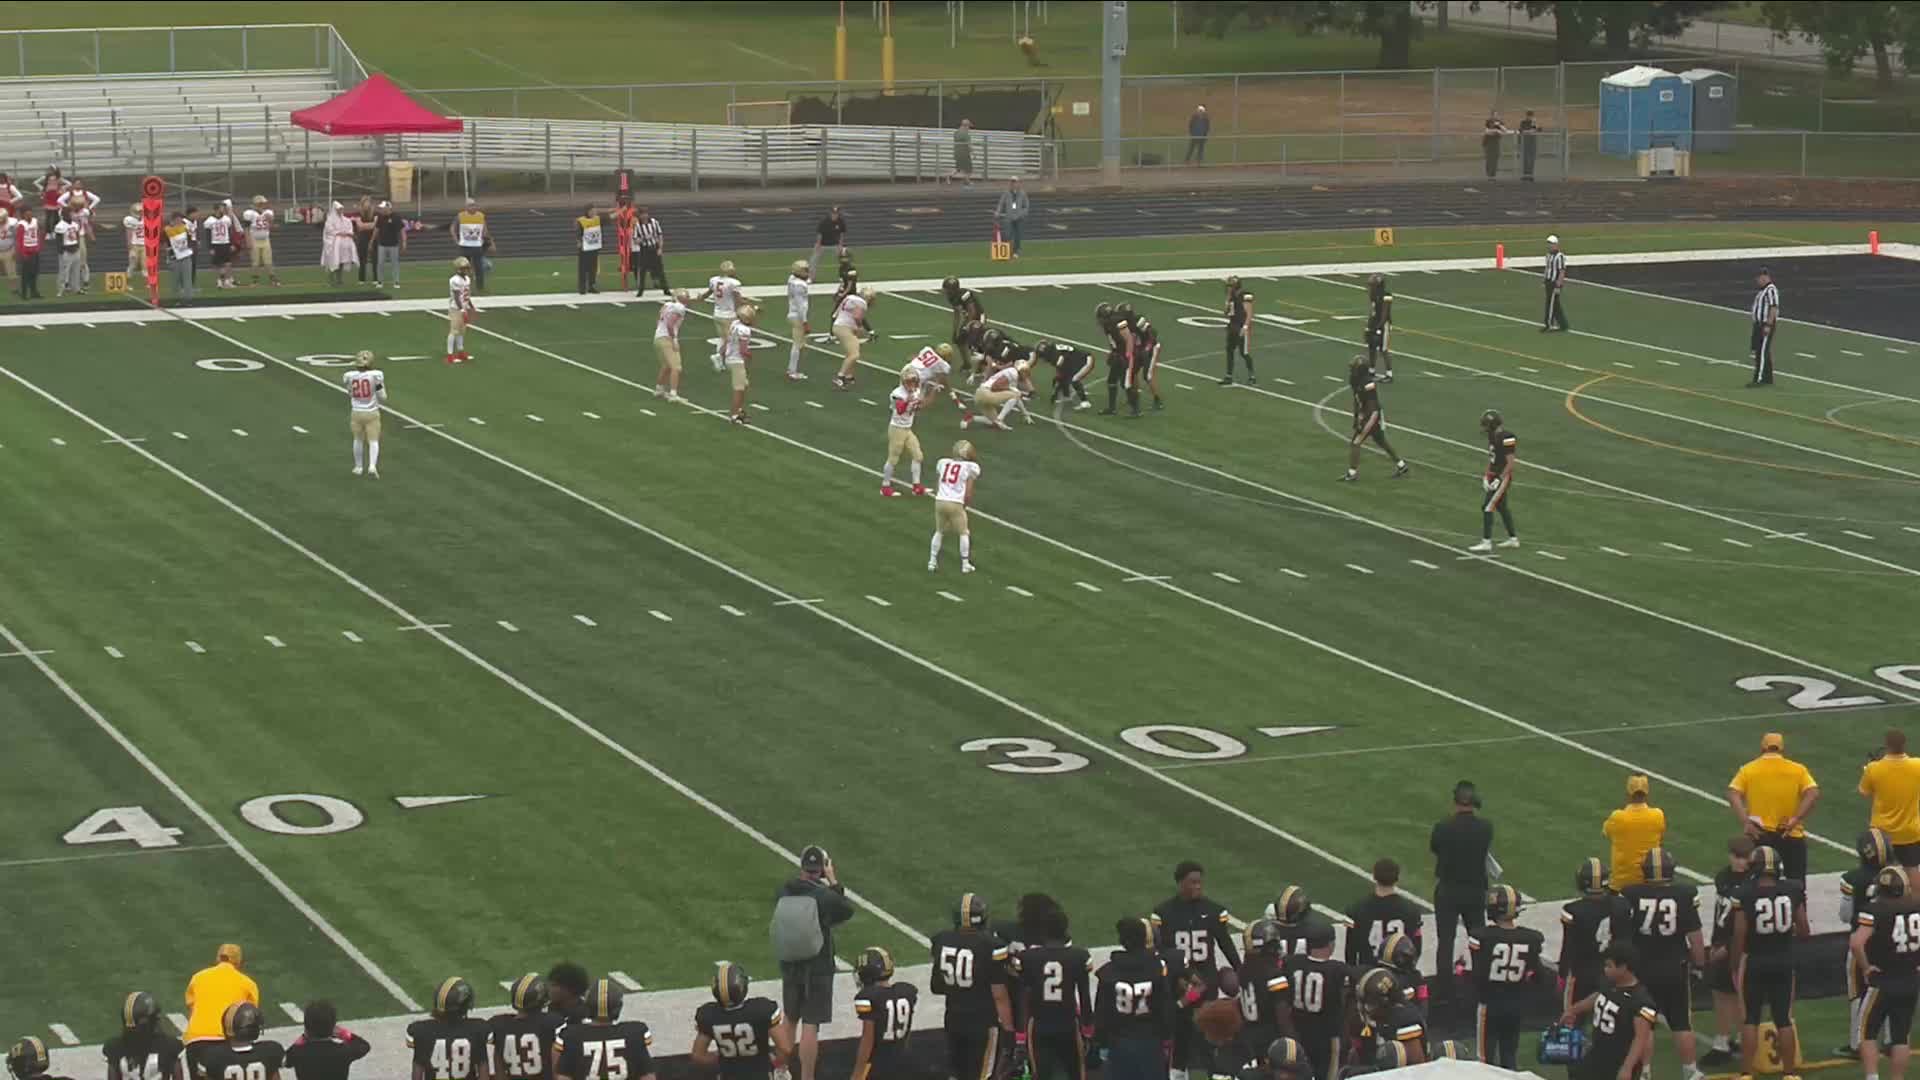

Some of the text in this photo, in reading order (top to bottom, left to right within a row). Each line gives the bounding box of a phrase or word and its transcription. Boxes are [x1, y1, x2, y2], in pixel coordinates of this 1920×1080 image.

[993, 243, 1009, 258] 10
[1380, 229, 1390, 243] G
[108, 274, 123, 290] 30
[918, 350, 940, 368] 50
[351, 378, 371, 399] 20
[941, 463, 961, 485] 19
[1639, 897, 1678, 937] 73
[1754, 895, 1793, 934] 20
[1892, 912, 1920, 953] 49
[939, 945, 974, 988] 50
[1042, 960, 1064, 1001] 2
[1489, 942, 1529, 982] 25
[1115, 980, 1153, 1015] 87
[1293, 969, 1324, 1013] 10
[882, 998, 911, 1040] 19
[430, 1037, 472, 1079] 48
[502, 1032, 544, 1076] 43
[582, 1039, 629, 1080] 75
[712, 1022, 759, 1058] 52
